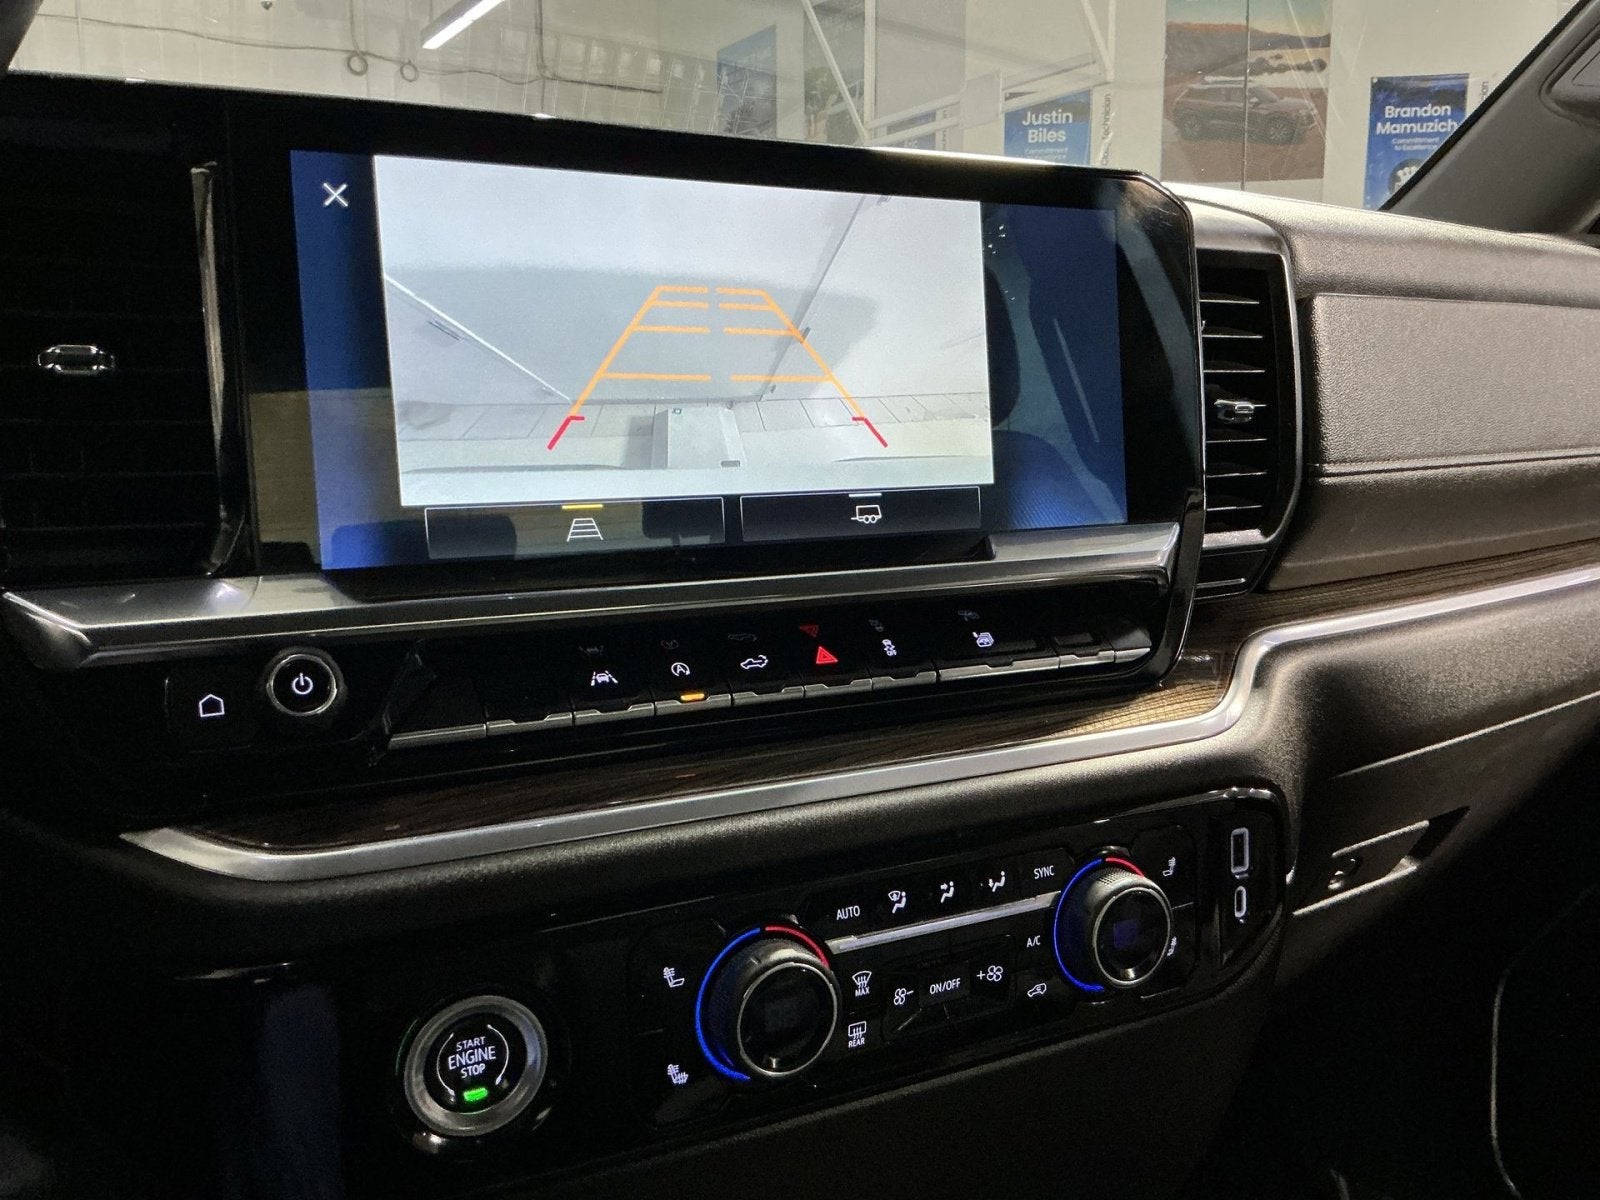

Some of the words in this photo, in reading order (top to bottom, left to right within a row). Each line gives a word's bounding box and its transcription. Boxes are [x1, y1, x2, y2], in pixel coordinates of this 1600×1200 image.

[1022, 109, 1073, 126] Justin
[1384, 103, 1452, 118] Brandon
[1376, 119, 1458, 134] Mamuzich
[1028, 128, 1067, 143] Biles
[1034, 865, 1055, 880] SYNC
[836, 905, 861, 920] AUTO
[1026, 935, 1041, 948] A/C
[855, 986, 870, 997] MAX
[929, 978, 961, 995] ON/OFF
[456, 1036, 486, 1052] START
[848, 1037, 865, 1048] REAR
[448, 1046, 496, 1070] ENGINE
[461, 1063, 486, 1078] STOP
